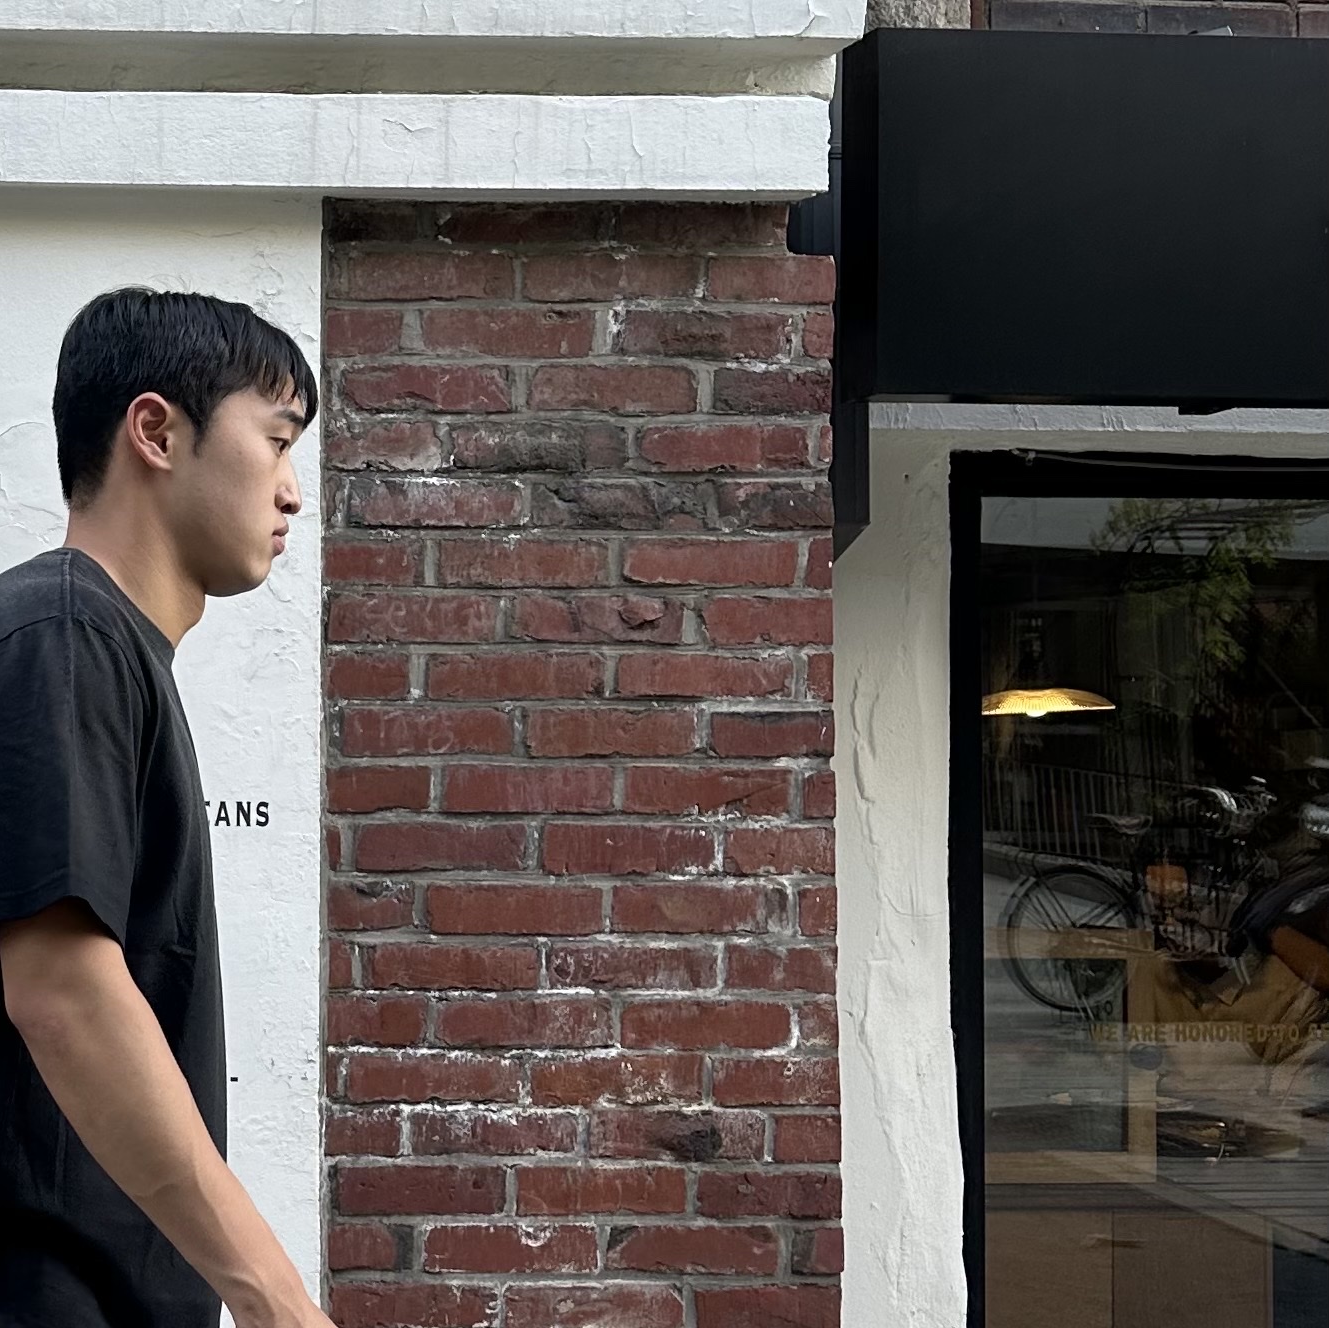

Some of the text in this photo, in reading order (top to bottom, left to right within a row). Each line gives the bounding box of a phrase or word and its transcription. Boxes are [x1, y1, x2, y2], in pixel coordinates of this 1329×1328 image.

[1087, 1023, 1119, 1042] WE
[1128, 1023, 1166, 1042] ARE
[1174, 1023, 1267, 1043] HONORED
